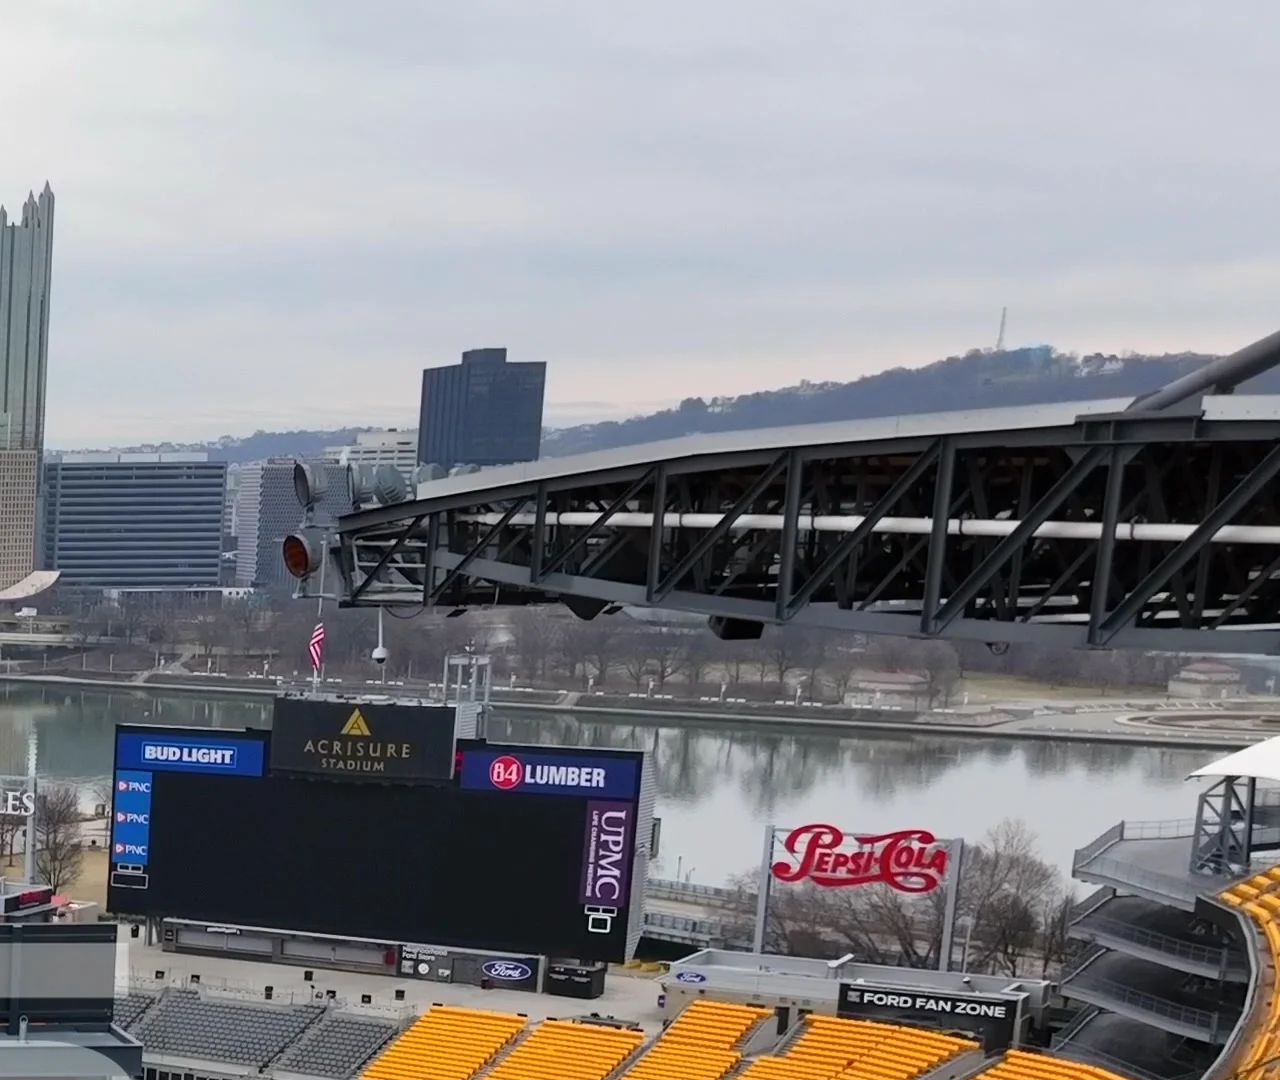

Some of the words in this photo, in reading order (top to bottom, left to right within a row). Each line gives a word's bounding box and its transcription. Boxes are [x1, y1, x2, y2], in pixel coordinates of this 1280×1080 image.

[144, 745, 181, 761] BUD
[182, 748, 234, 764] LIGHT
[303, 739, 411, 758] ACRISURE
[321, 757, 385, 772] STADIUM
[493, 763, 518, 783] 84
[525, 766, 606, 788] LUMBER
[128, 781, 151, 792] PNC
[126, 813, 149, 824] PNC
[125, 844, 147, 855] PNC
[595, 810, 627, 900] UPMC
[491, 964, 521, 978] Ford
[863, 992, 912, 1008] FORD
[915, 998, 952, 1012] FAN
[954, 1002, 1007, 1018] ZONE
